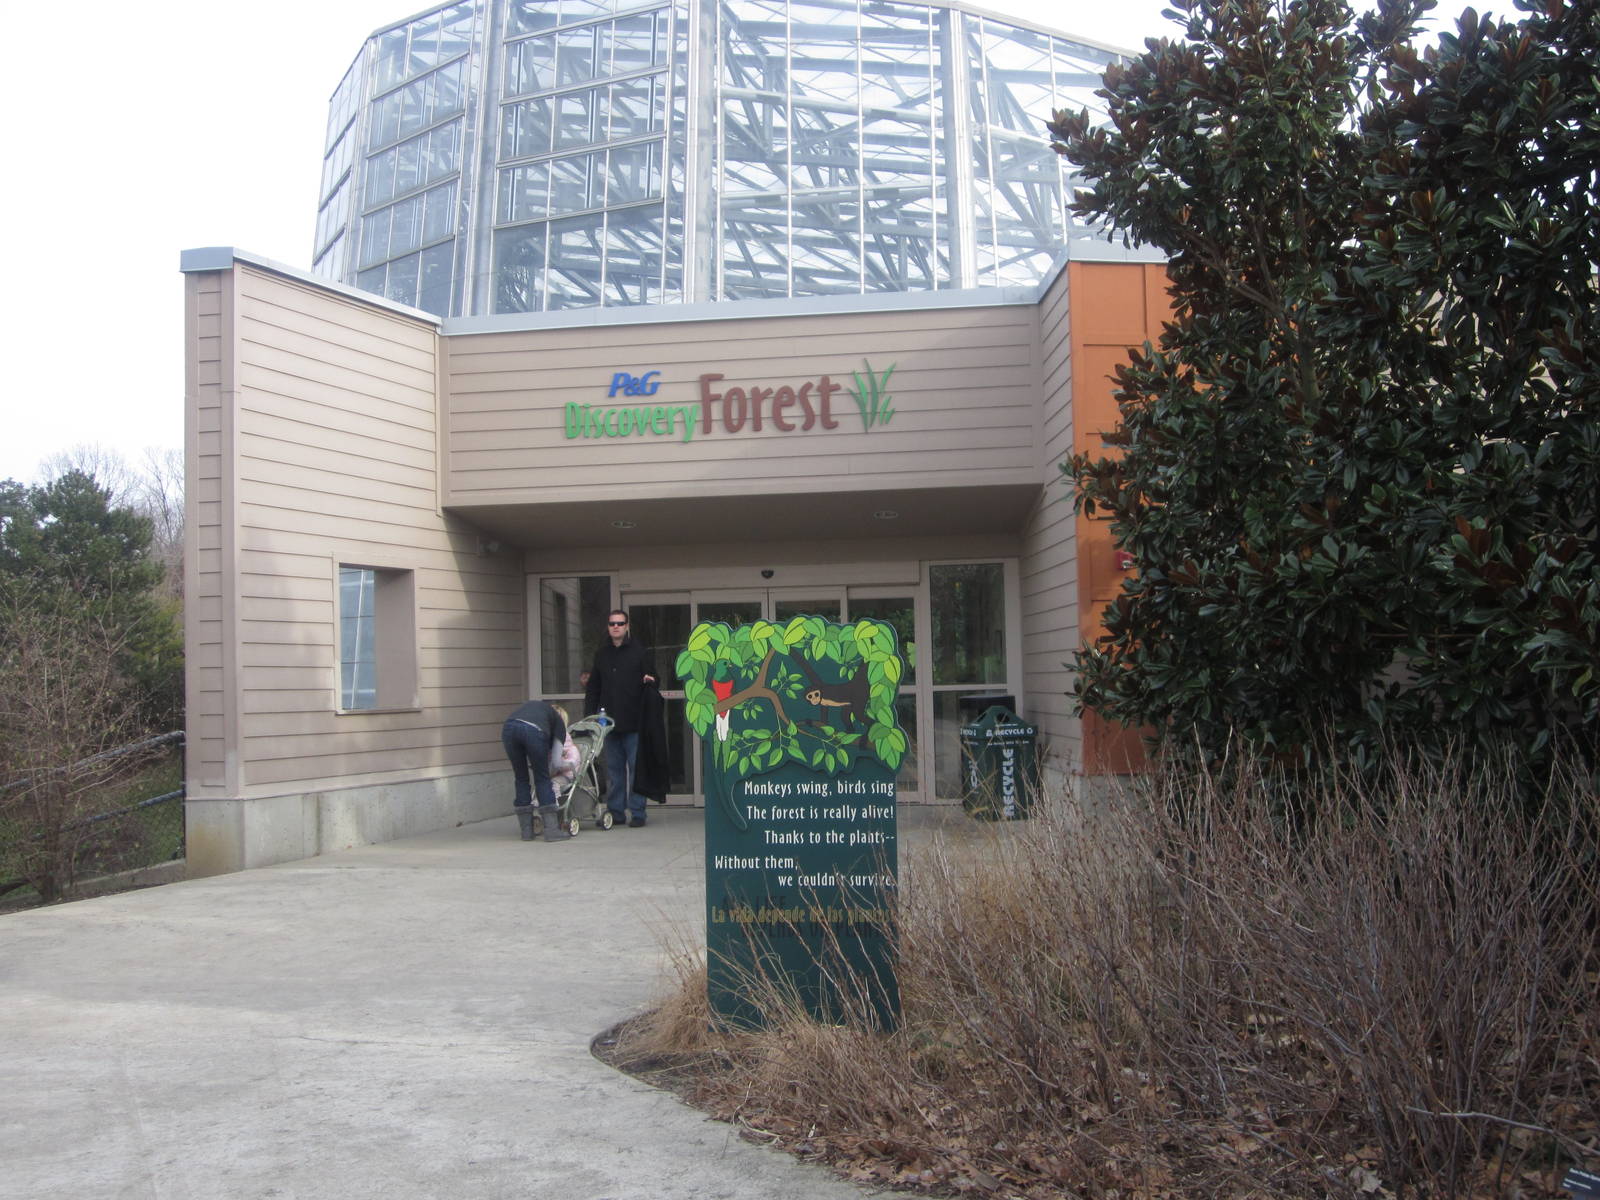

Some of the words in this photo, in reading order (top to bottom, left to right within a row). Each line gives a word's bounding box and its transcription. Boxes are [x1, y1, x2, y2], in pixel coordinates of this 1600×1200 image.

[608, 370, 661, 398] P&G
[564, 401, 700, 444] Discovery
[700, 373, 842, 435] Forest
[744, 781, 792, 798] Monkeys
[796, 781, 832, 797] swing,
[837, 780, 866, 794] birds
[871, 780, 894, 797] sing
[1002, 748, 1015, 817] RECYCLE
[747, 805, 767, 819] The
[771, 805, 805, 821] forest
[810, 805, 818, 819] is
[823, 805, 857, 822] really
[862, 805, 894, 819] alive!
[764, 830, 804, 844] Thanks
[809, 831, 821, 844] to
[826, 830, 845, 844] the
[715, 855, 760, 869] Without
[765, 855, 799, 871] them,
[778, 875, 793, 886] we
